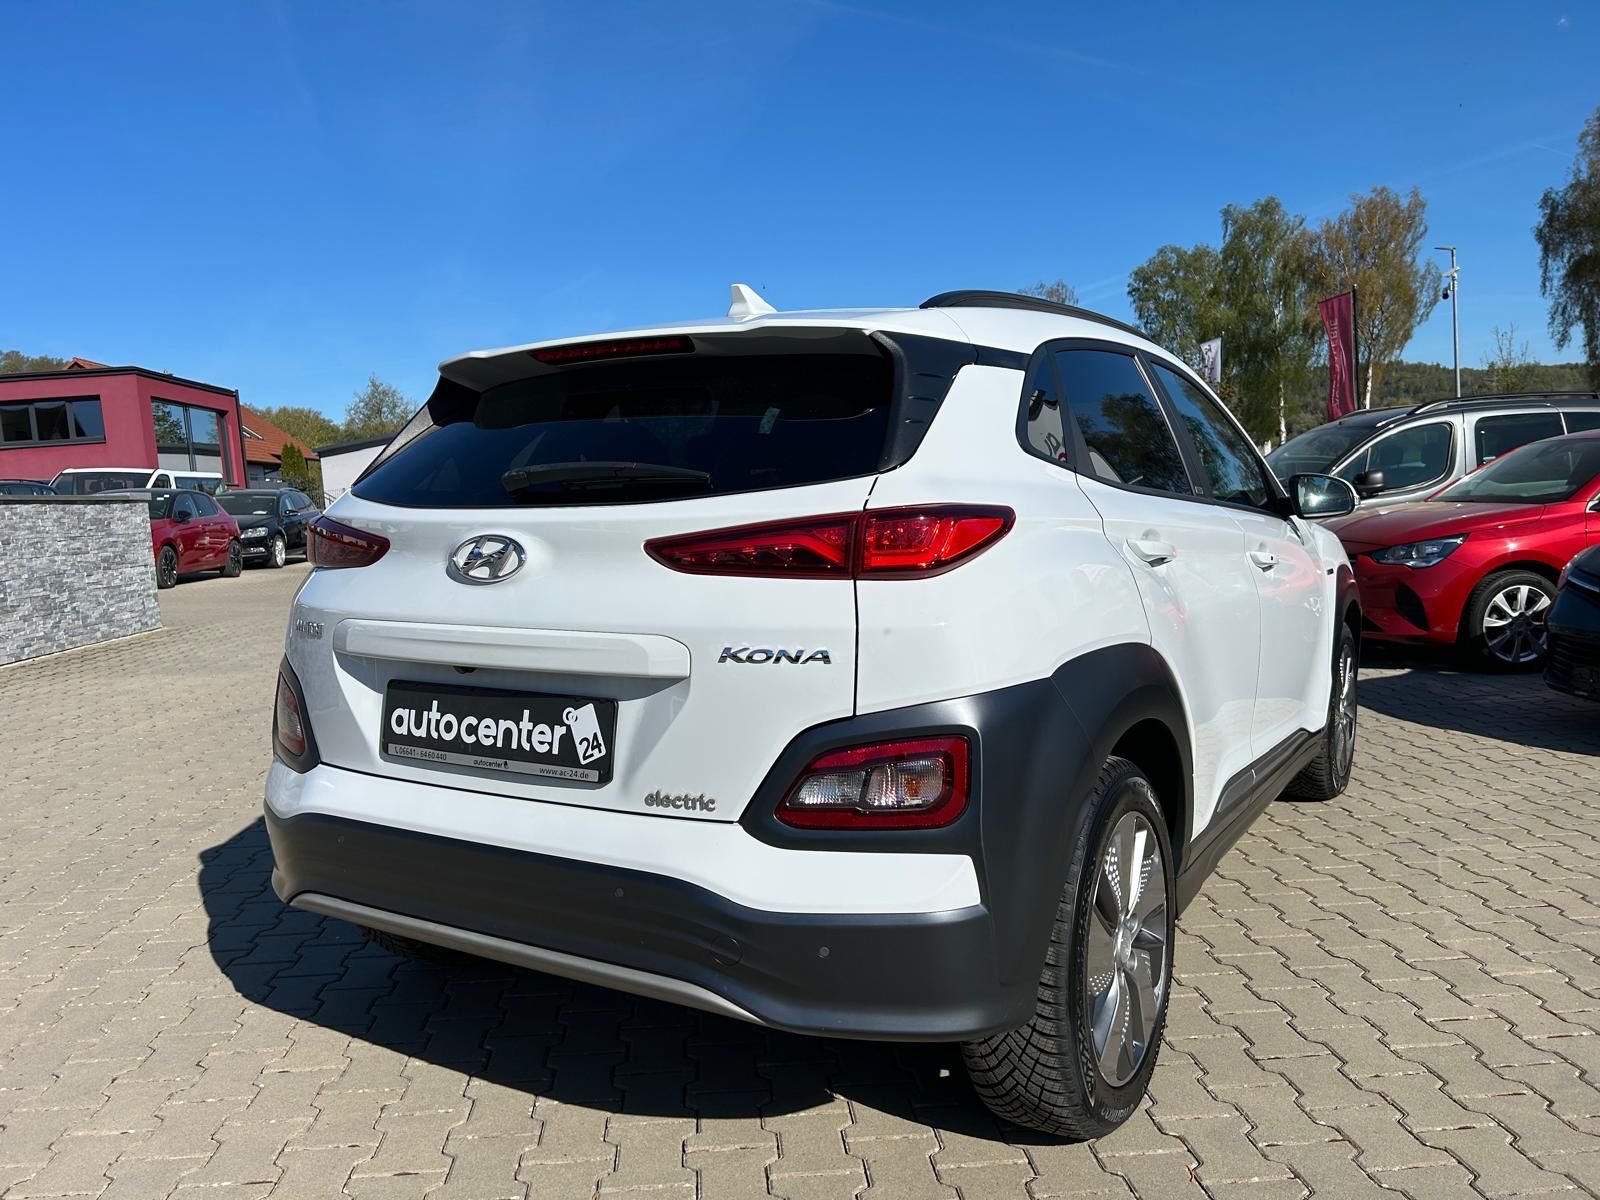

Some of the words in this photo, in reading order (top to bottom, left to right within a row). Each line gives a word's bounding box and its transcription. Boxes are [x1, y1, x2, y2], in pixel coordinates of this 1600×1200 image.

[717, 647, 832, 665] KONA
[391, 700, 567, 755] autocenter
[579, 732, 603, 761] 24
[539, 767, 589, 780] www.ac-24.de
[644, 790, 716, 812] electric
